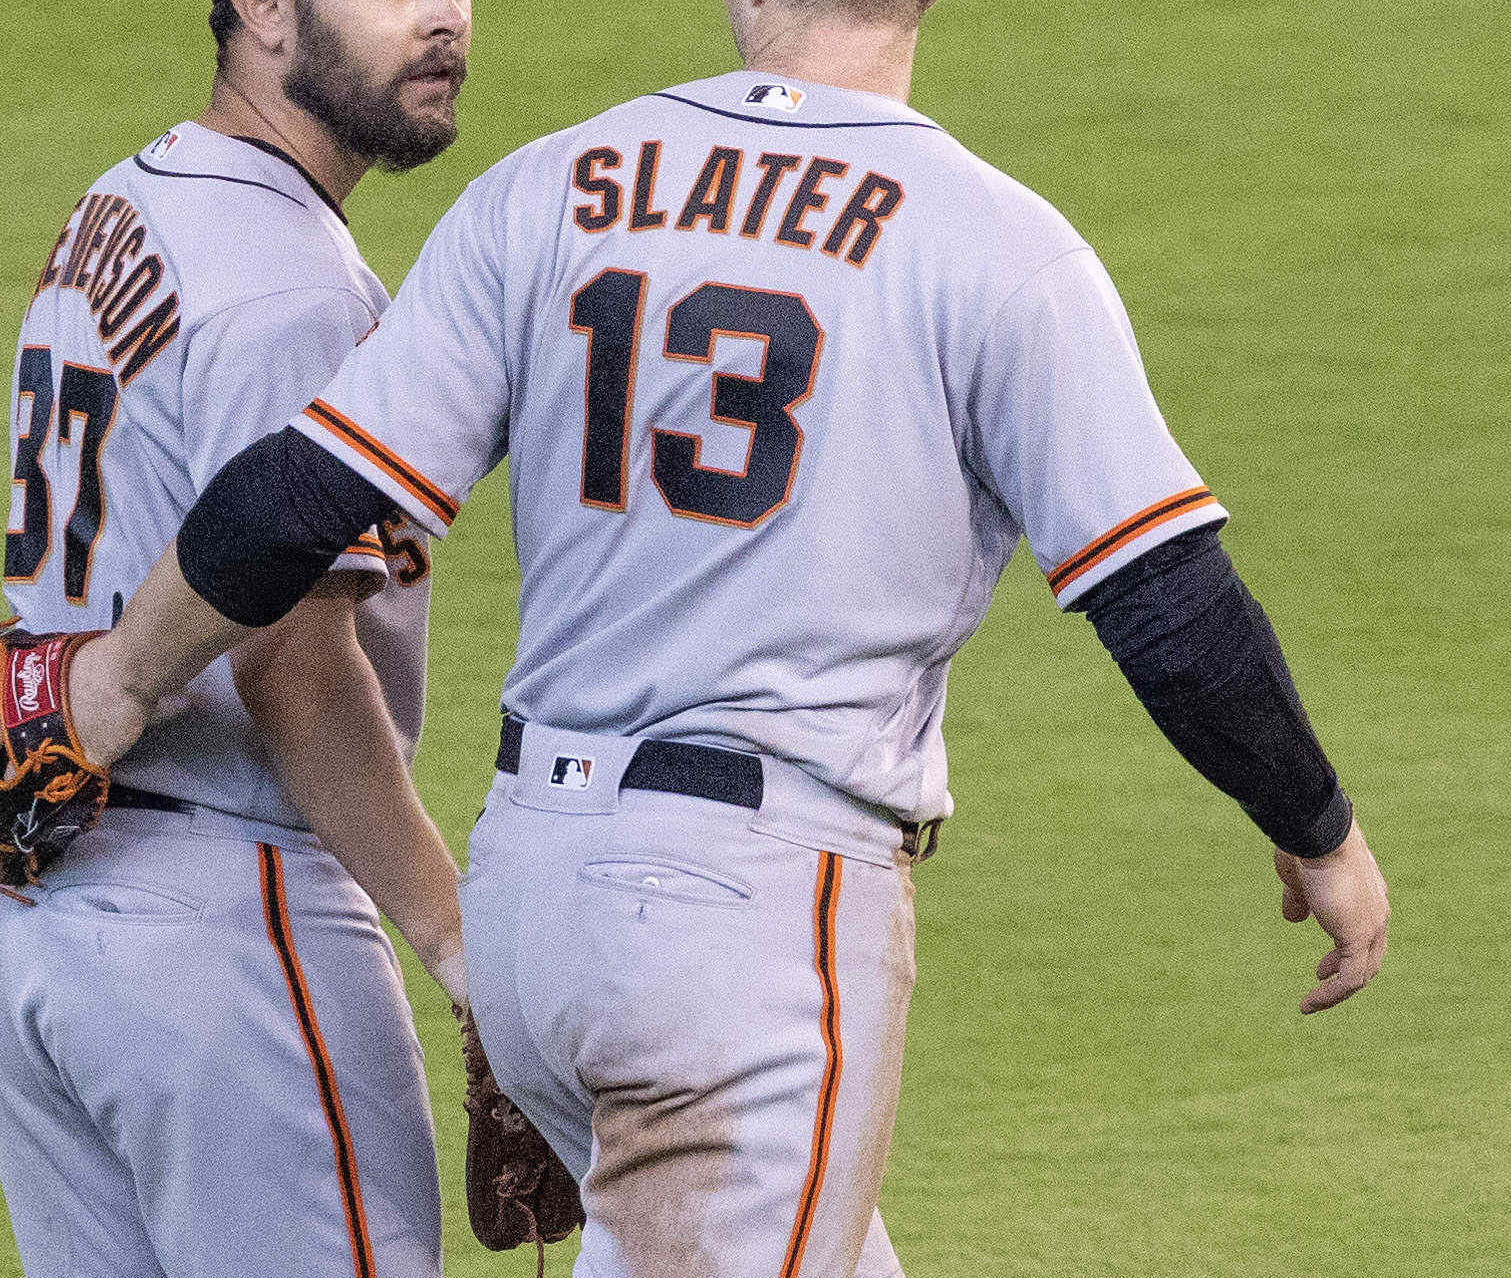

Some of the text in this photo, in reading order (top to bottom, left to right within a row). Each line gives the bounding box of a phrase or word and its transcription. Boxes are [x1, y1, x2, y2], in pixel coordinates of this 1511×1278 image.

[25, 193, 181, 389] EVENSON
[572, 139, 906, 270] SLATER
[2, 343, 120, 606] 37
[568, 266, 827, 530] 13
